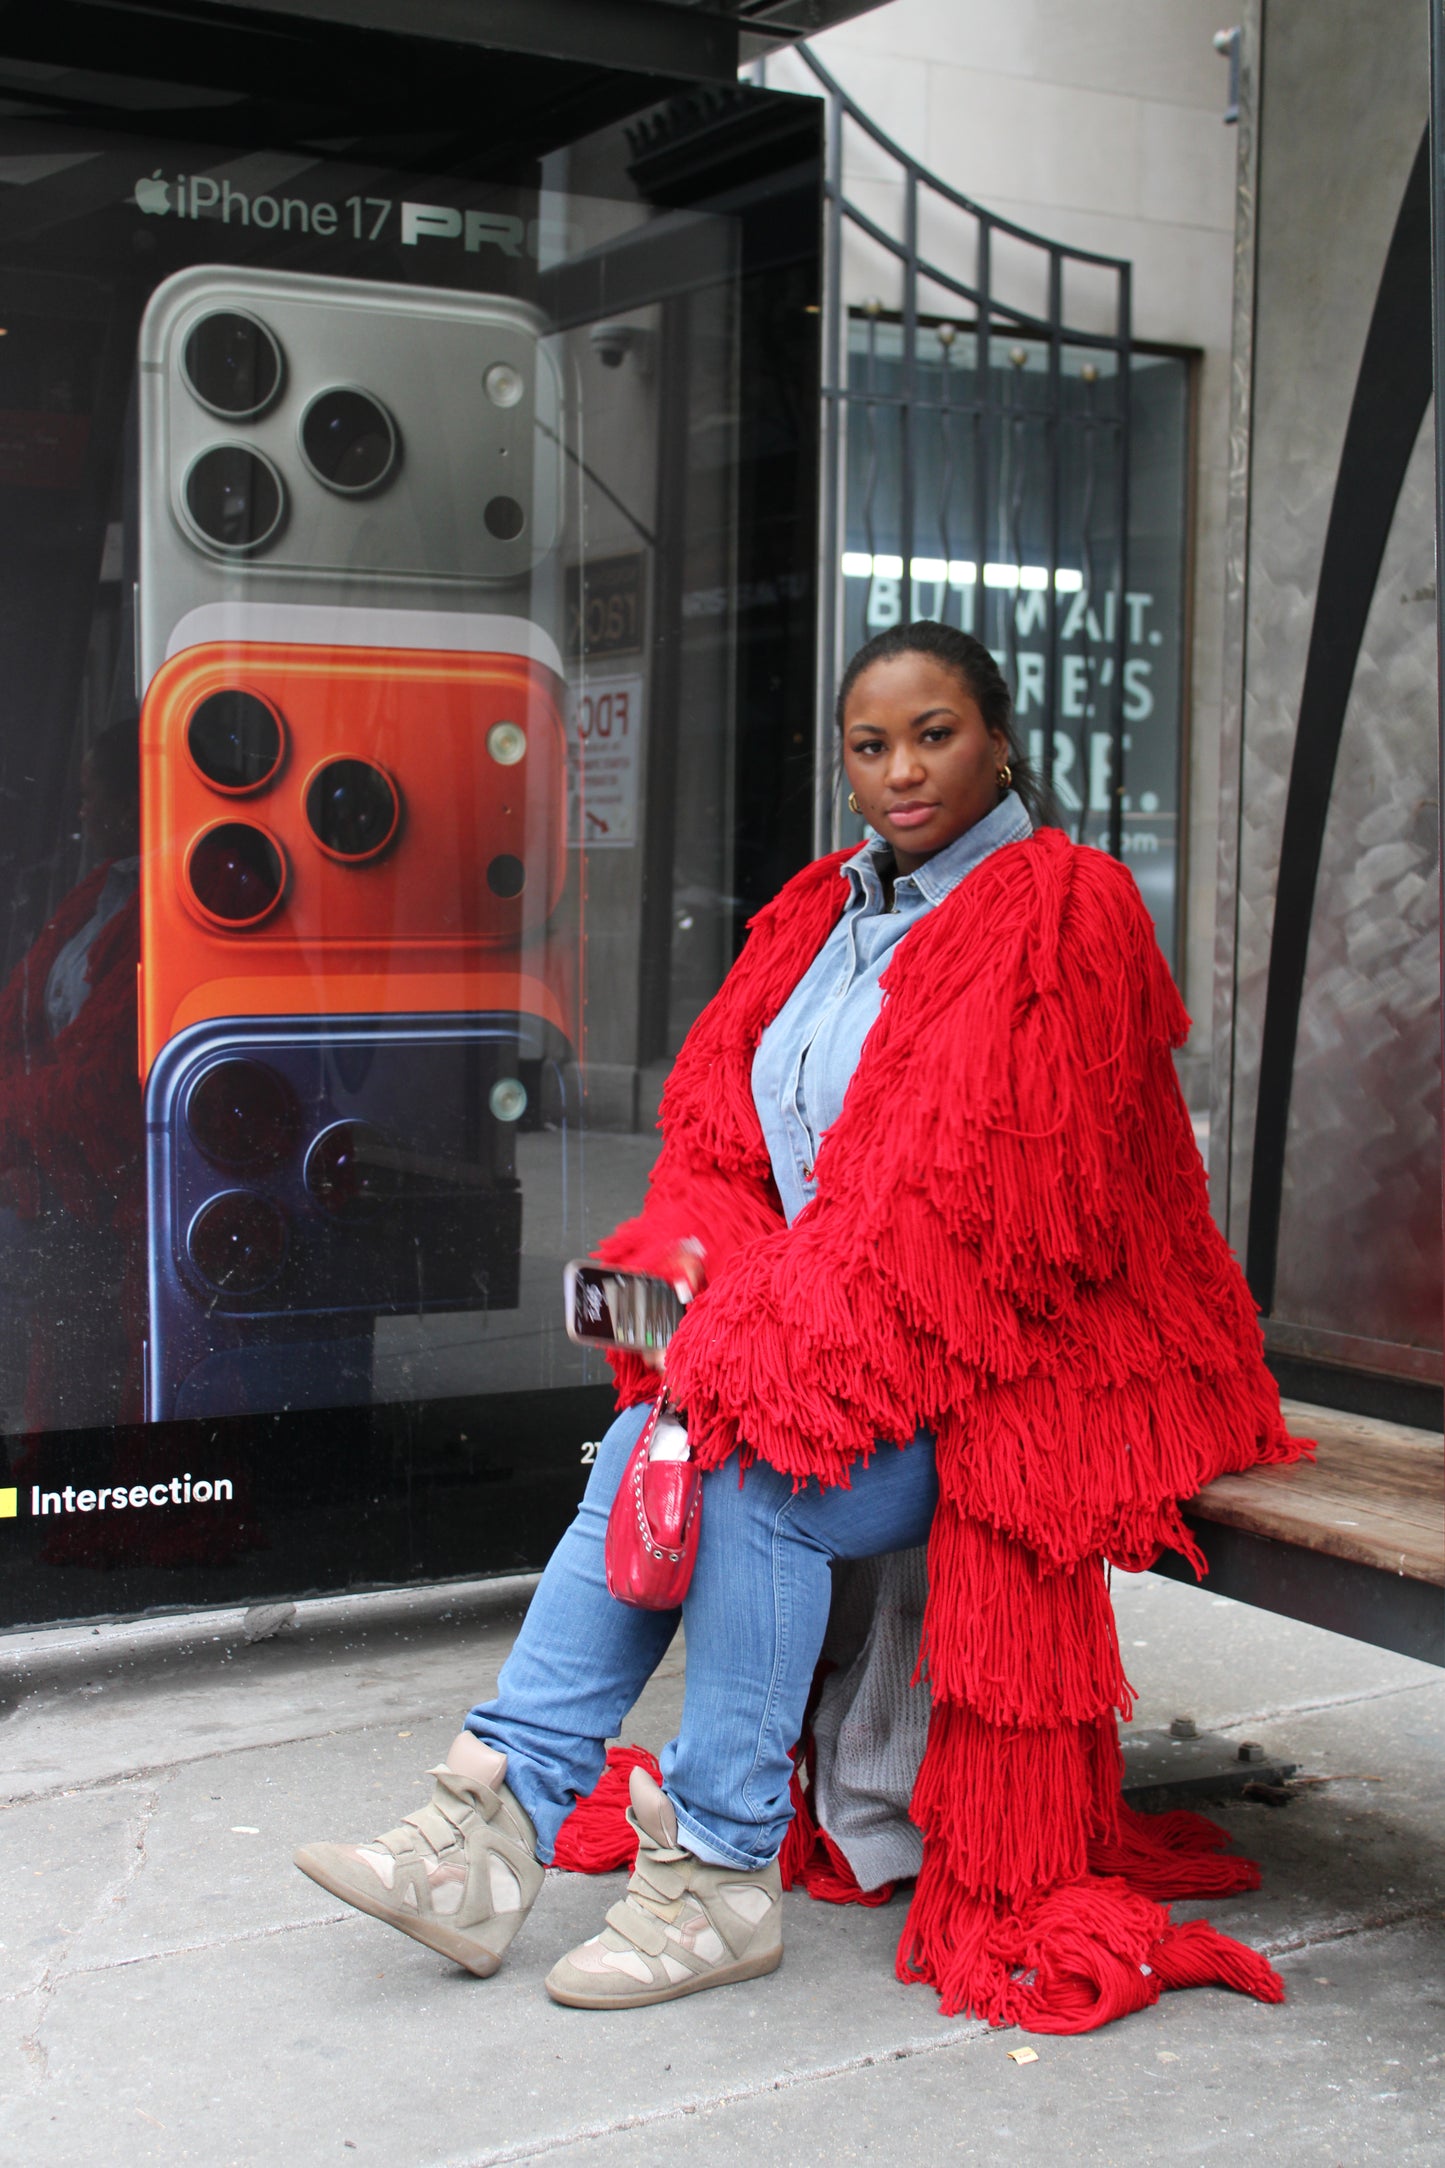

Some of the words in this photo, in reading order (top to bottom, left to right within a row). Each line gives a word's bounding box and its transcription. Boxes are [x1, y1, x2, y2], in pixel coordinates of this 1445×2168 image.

[177, 174, 338, 235] iPhone
[345, 196, 392, 241] 17
[867, 577, 976, 634] BUT
[989, 650, 1154, 722] RE'S
[1029, 729, 1159, 813] RE.
[32, 1473, 233, 1516] Intersection
